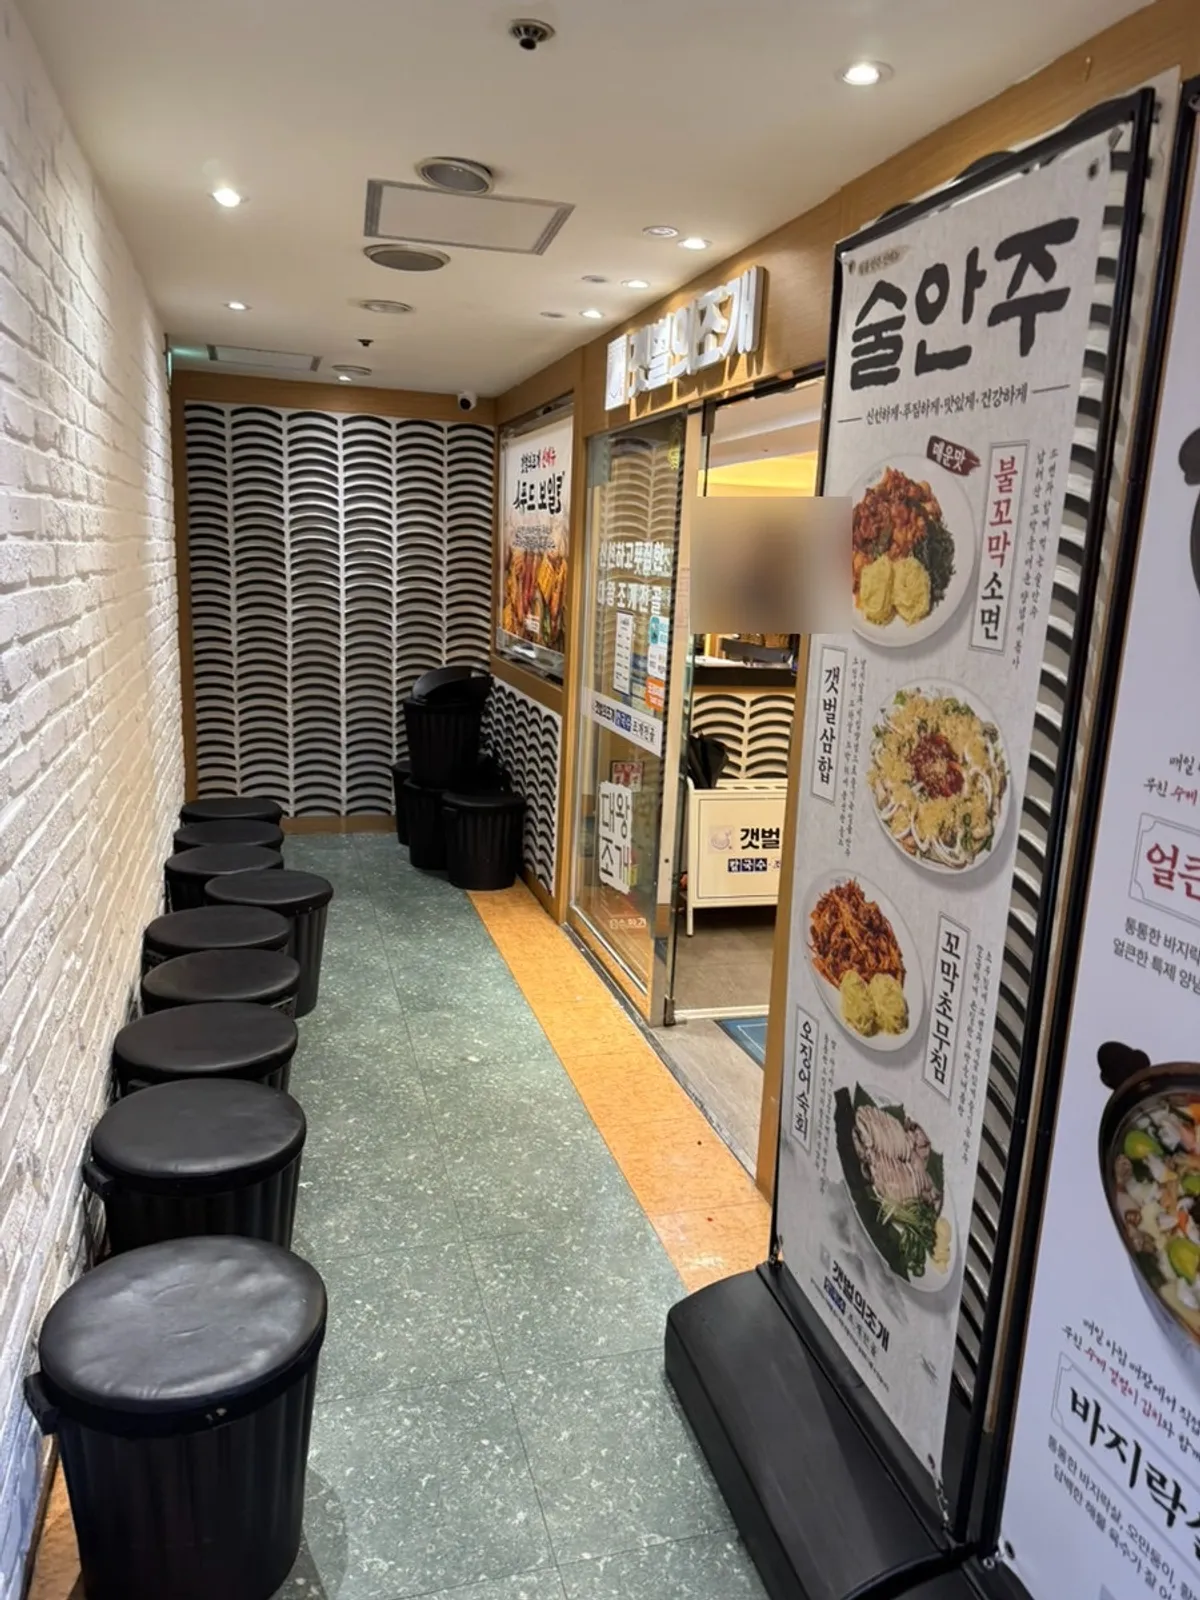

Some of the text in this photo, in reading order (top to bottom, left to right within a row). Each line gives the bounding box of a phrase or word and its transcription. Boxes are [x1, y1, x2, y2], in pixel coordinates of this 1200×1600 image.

[850, 217, 1079, 391] 술안주
[932, 440, 966, 472] 매운맛
[980, 455, 1018, 641] 불꼬막소면
[817, 666, 841, 785] 갯벌삼합
[1169, 753, 1195, 776] 매일
[601, 792, 630, 840] 대왕
[600, 836, 630, 883] 조개
[1125, 916, 1161, 947] 통통한
[1113, 937, 1148, 968] 얼큰한
[1151, 955, 1177, 983] 특제
[930, 930, 960, 1086] 꼬막초무침
[1083, 1319, 1104, 1346] 매일
[1106, 1338, 1127, 1368] 아침
[1128, 1362, 1177, 1413] 매장에서
